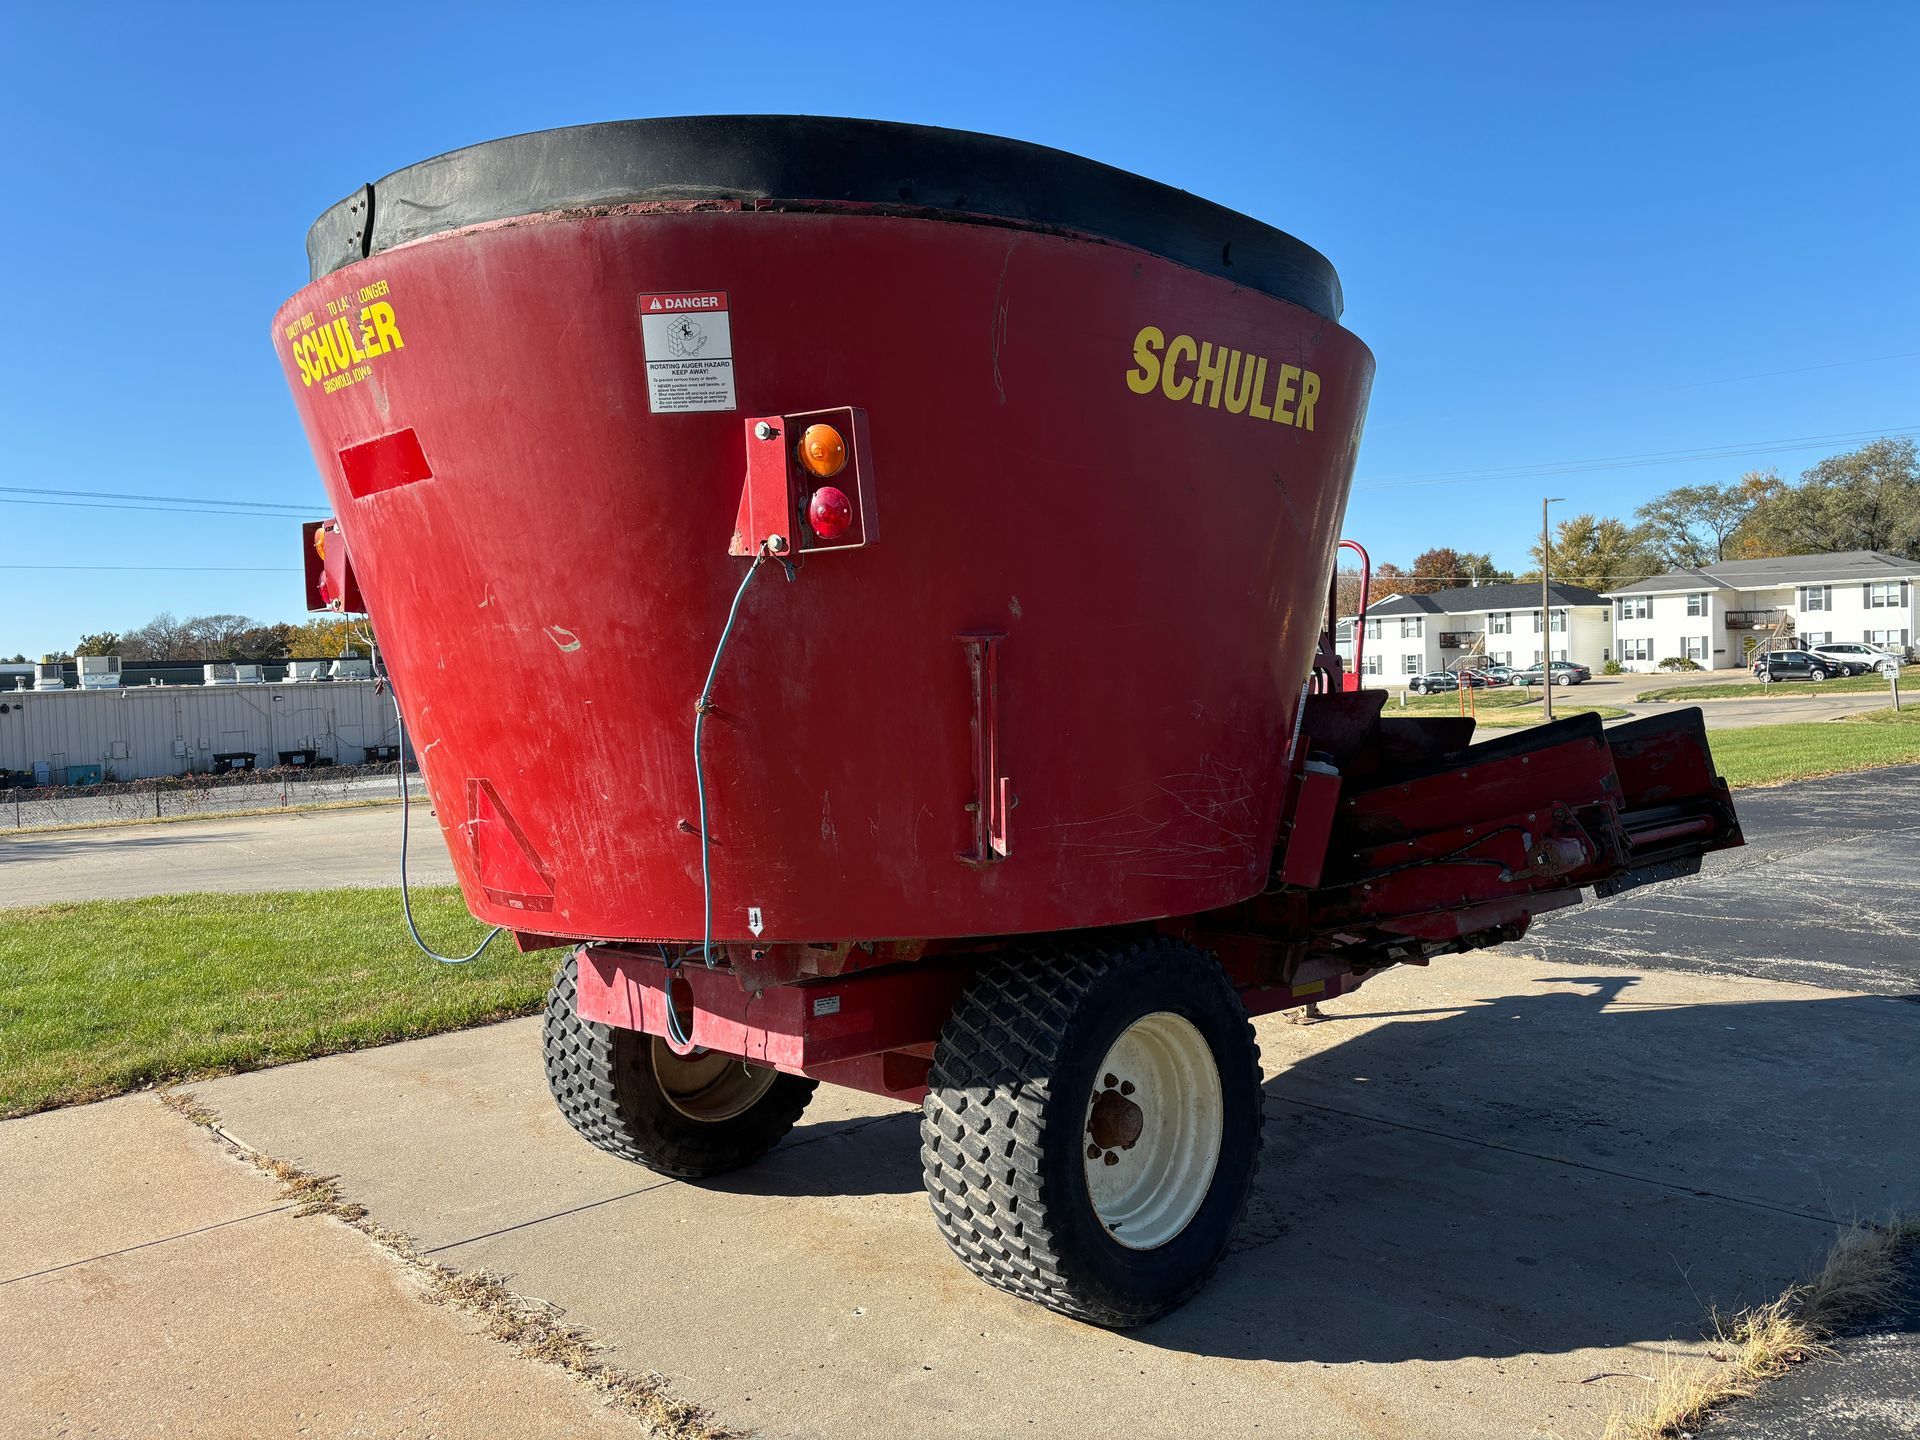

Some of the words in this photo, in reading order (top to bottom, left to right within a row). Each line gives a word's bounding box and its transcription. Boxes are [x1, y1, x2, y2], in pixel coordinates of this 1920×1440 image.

[326, 301, 338, 316] TO
[356, 280, 390, 304] LONGER
[665, 296, 718, 308] DANGER
[292, 302, 404, 387] SCHULER
[1126, 326, 1321, 431] SCHULER
